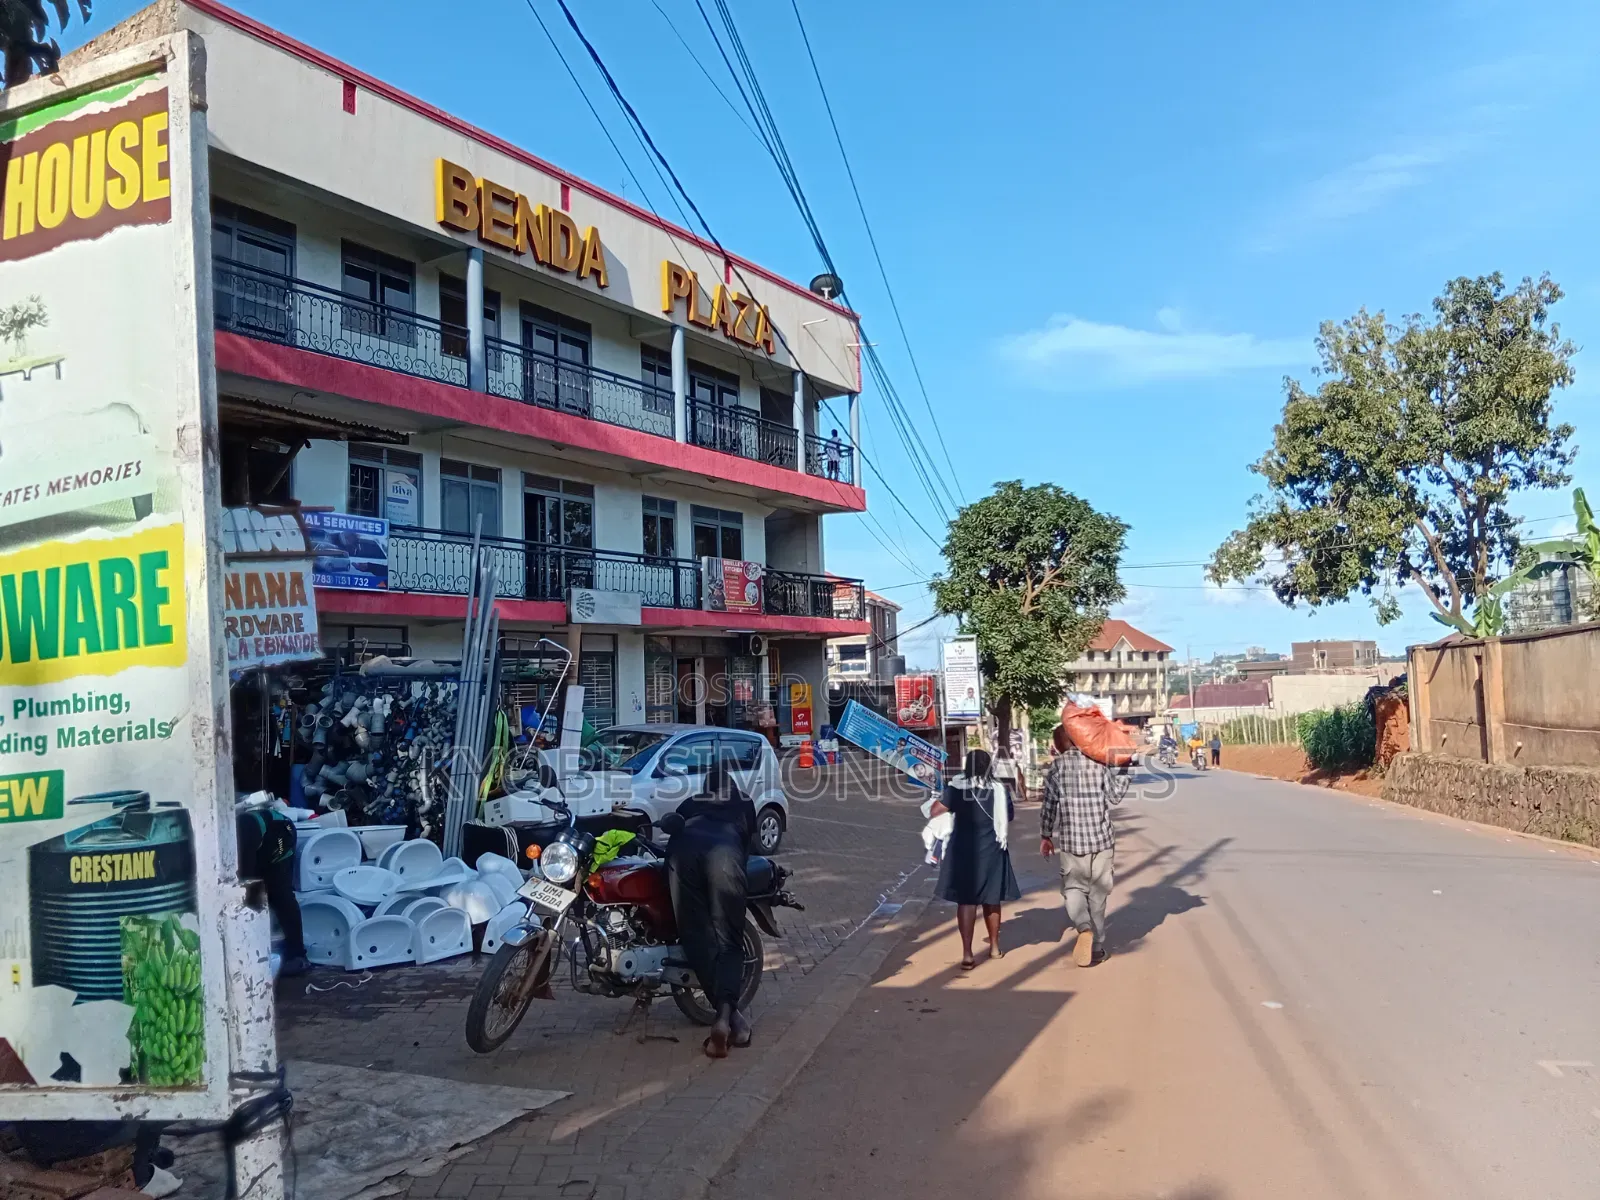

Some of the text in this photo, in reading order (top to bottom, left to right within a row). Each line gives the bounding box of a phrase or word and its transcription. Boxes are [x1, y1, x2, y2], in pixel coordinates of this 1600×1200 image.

[3, 111, 170, 240] HOUSE
[435, 156, 775, 354] BENDA PLAZA
[0, 460, 142, 507] ATES MEMORIES
[302, 514, 321, 526] AL
[323, 516, 382, 533] SERVICES
[354, 577, 369, 587] 732
[0, 550, 174, 664] WARE
[224, 613, 304, 639] RDWARE
[13, 692, 131, 720] Plumbing,
[57, 718, 173, 749] Materials
[70, 850, 155, 883] CRESTANK
[543, 885, 563, 898] UMA
